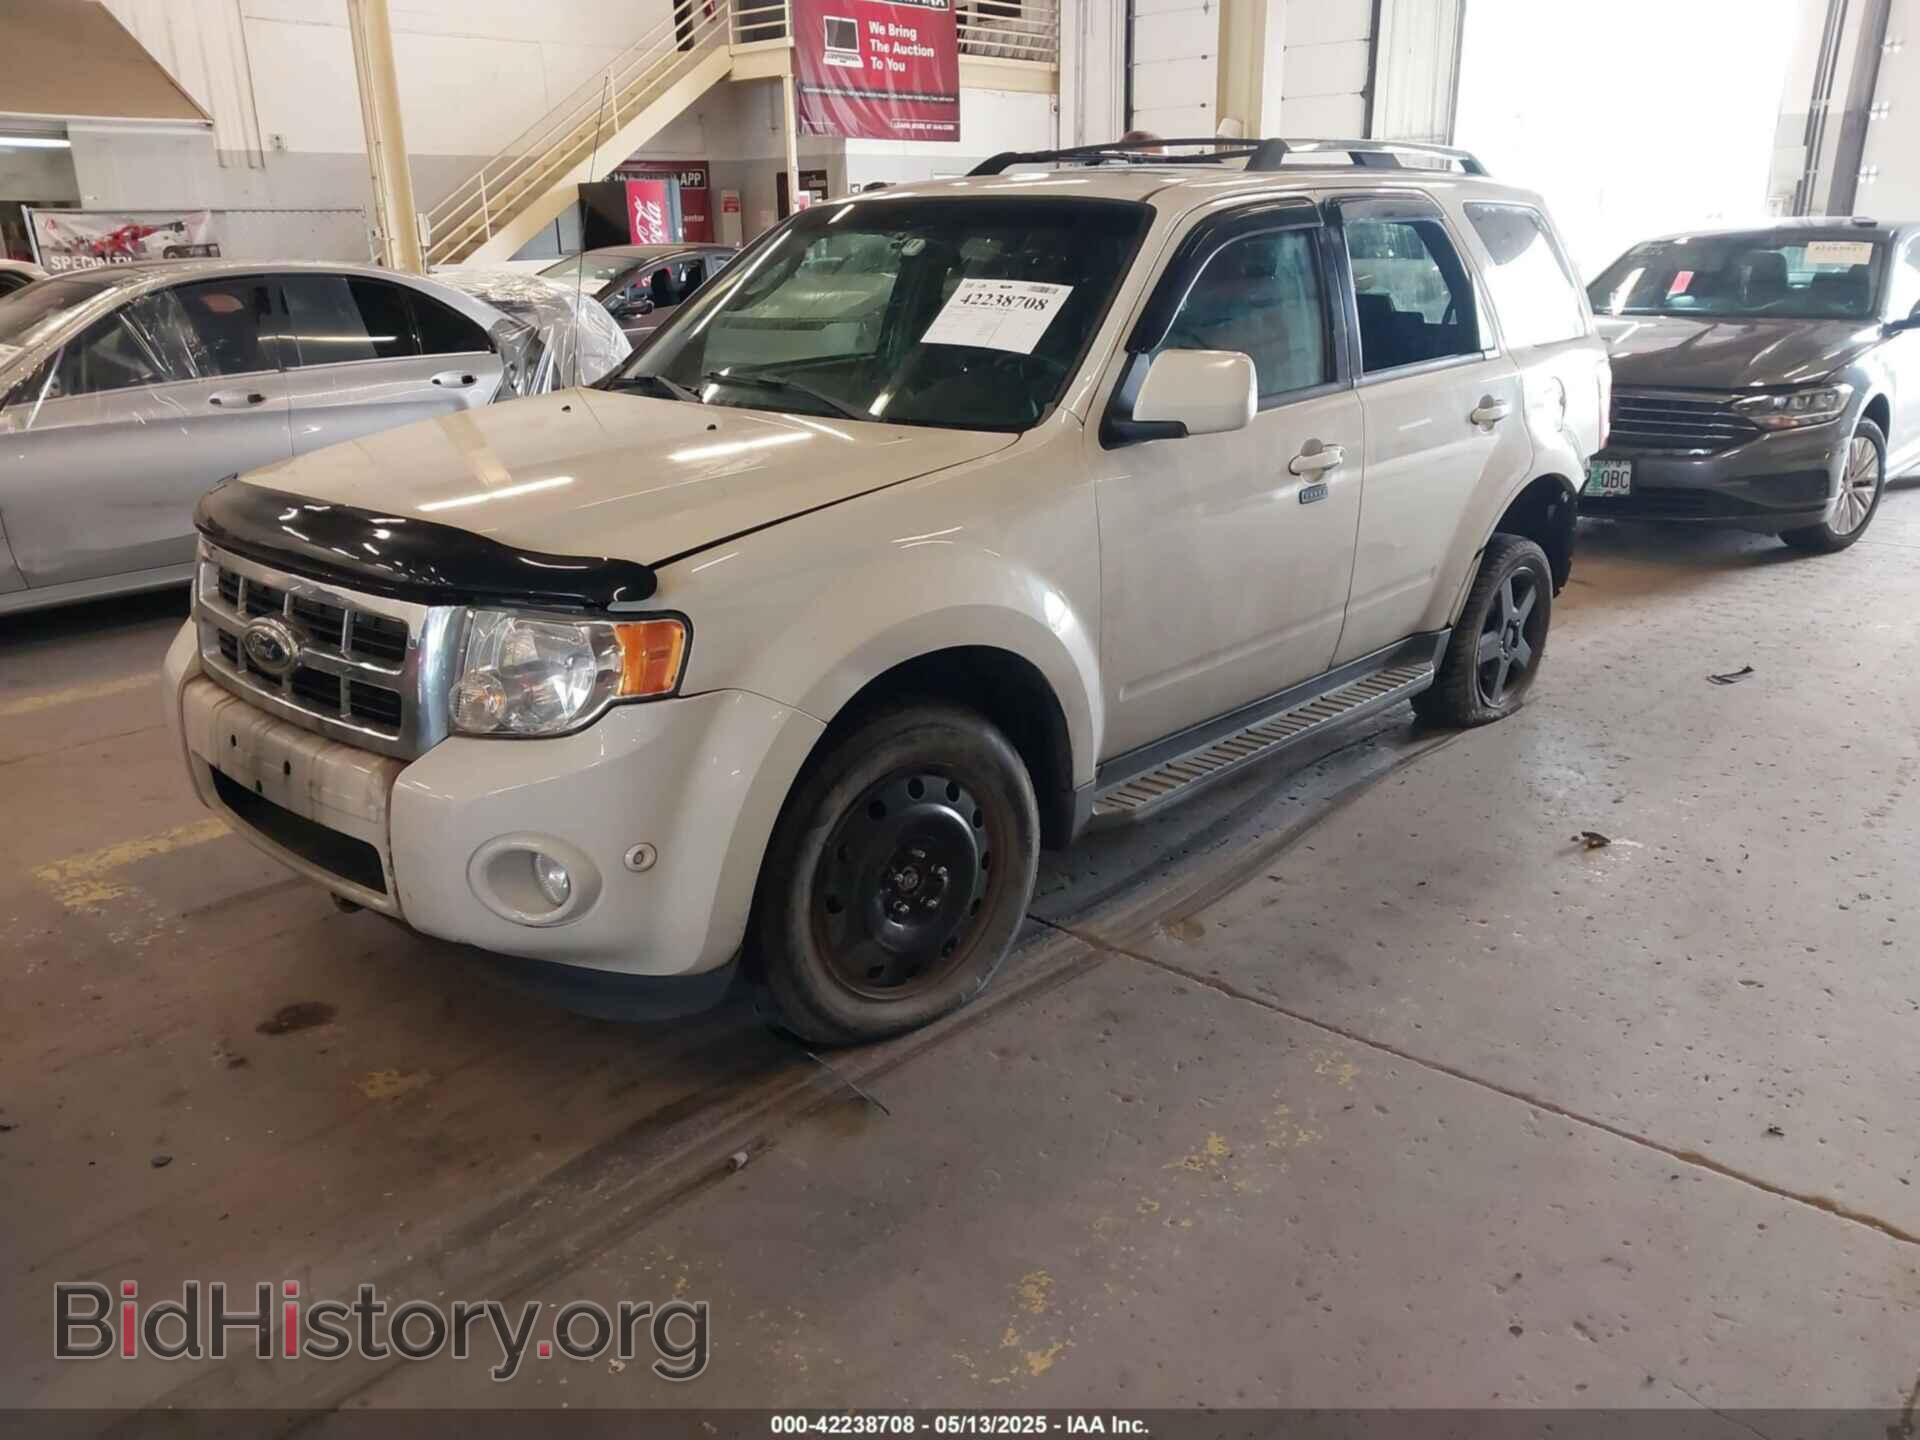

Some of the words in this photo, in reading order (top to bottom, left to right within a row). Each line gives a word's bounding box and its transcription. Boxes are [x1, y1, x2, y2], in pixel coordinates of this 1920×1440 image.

[869, 21, 886, 35] We
[888, 23, 917, 41] Bring
[870, 38, 890, 53] The
[893, 41, 934, 57] Auction
[870, 56, 884, 70] To
[886, 57, 906, 72] You
[680, 172, 702, 186] APP
[961, 293, 1049, 311] 42238708
